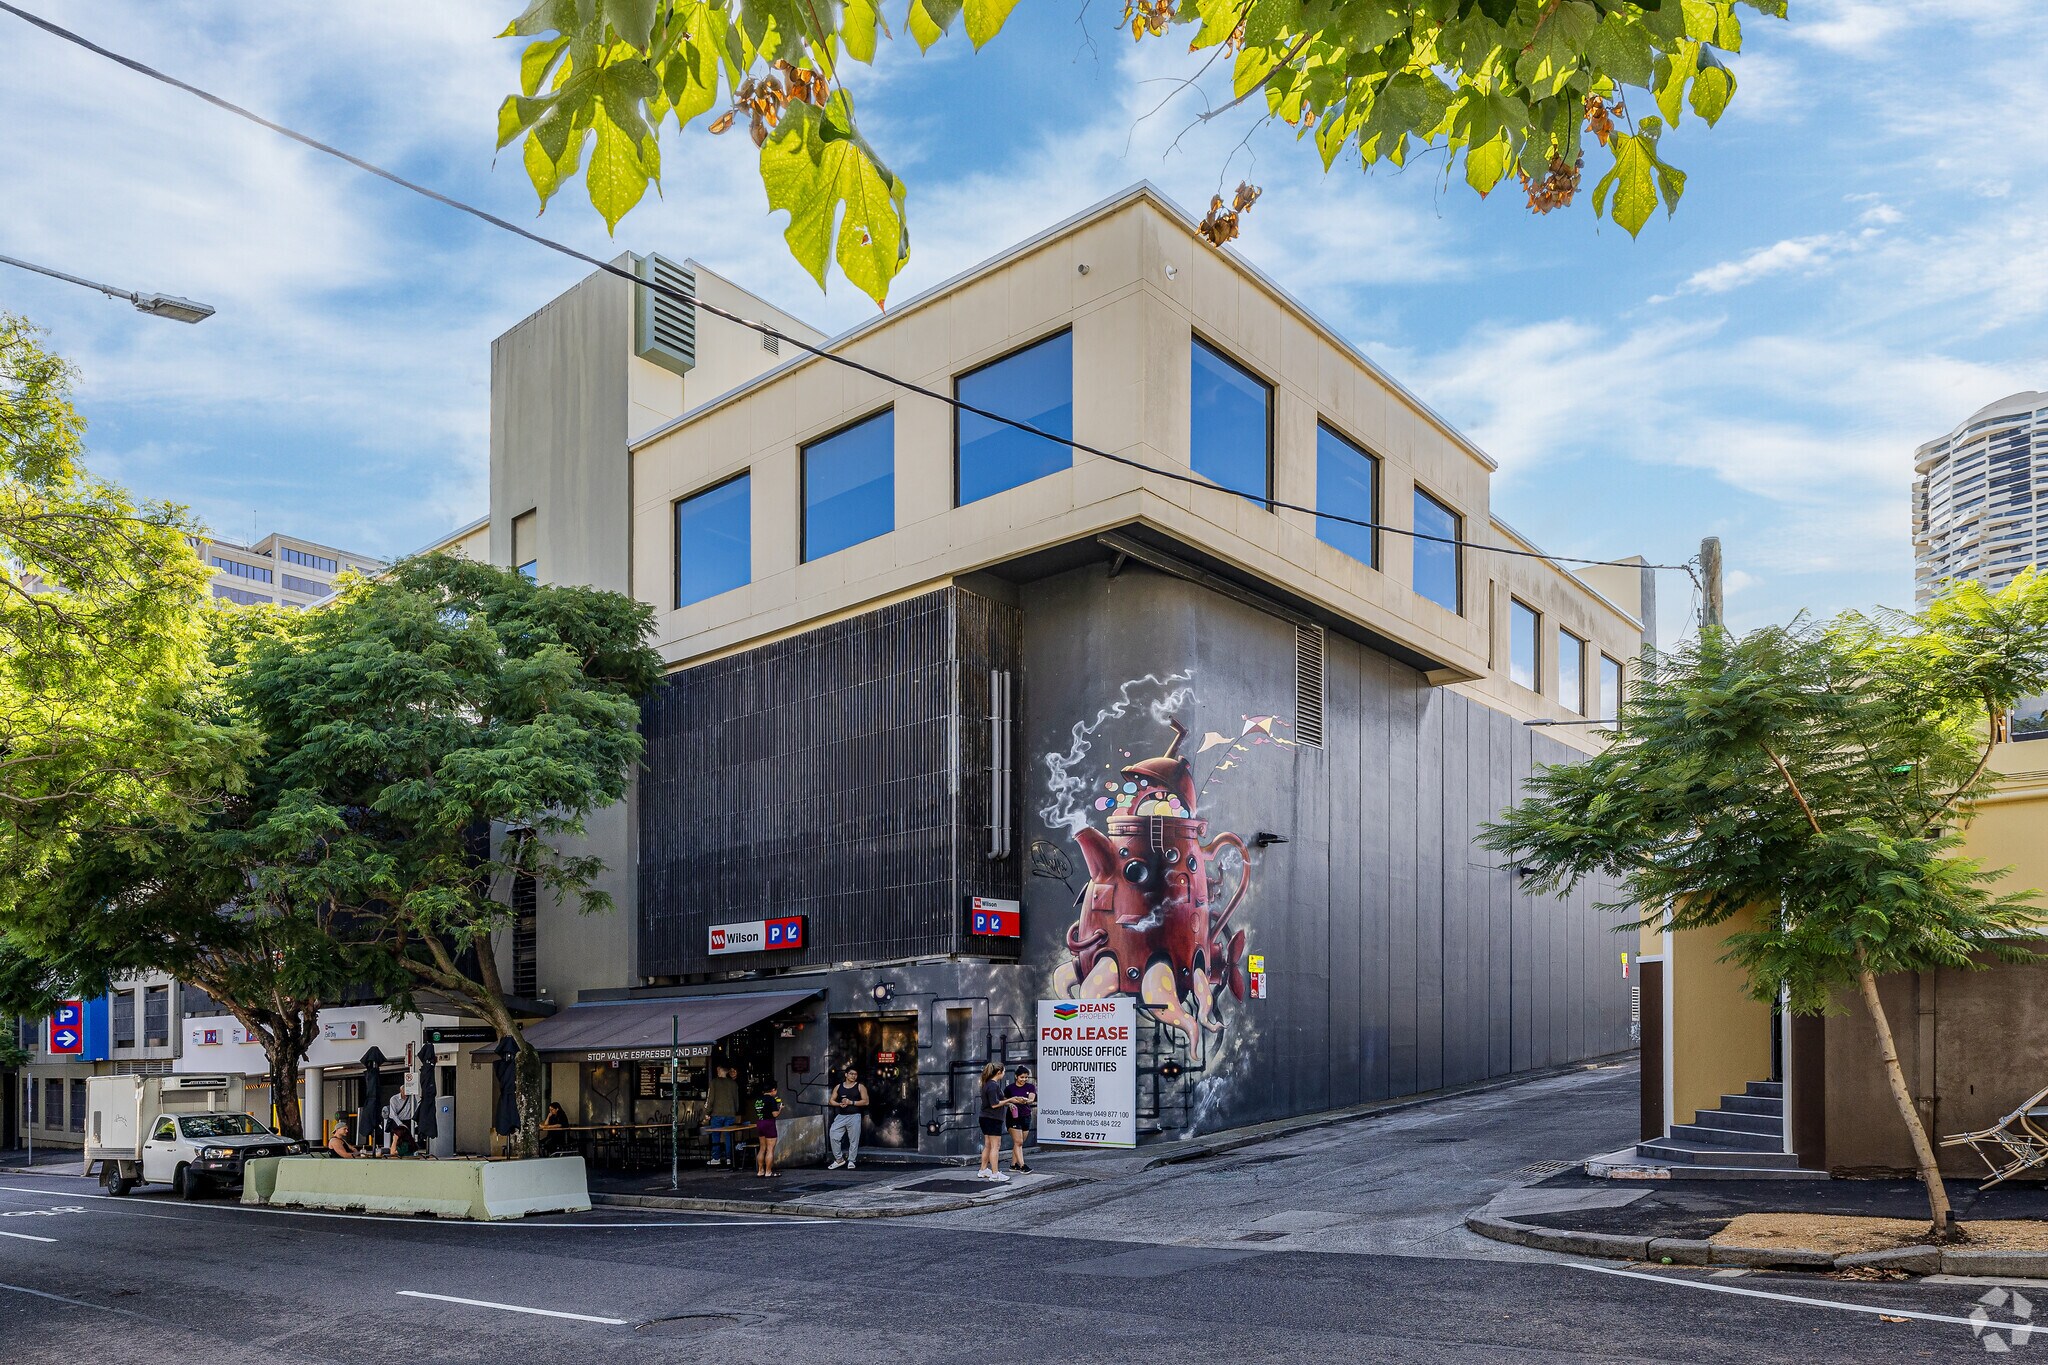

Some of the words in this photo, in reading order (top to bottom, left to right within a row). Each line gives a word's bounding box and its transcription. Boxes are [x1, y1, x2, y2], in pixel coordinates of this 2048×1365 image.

[977, 916, 984, 928] P
[727, 933, 758, 943] Wilson
[771, 927, 780, 940] P
[1079, 1003, 1115, 1012] DEANS
[60, 1009, 73, 1022] P
[1041, 1027, 1073, 1040] FOR
[1077, 1026, 1128, 1040] LEASE
[587, 1052, 606, 1060] STOP
[607, 1051, 628, 1060] VALVE
[630, 1049, 670, 1058] ESPRESSO
[692, 1046, 708, 1055] BAR
[1043, 1046, 1092, 1056] PENTHOUSE
[1096, 1046, 1126, 1056] OFFICE
[1052, 1062, 1116, 1072] OPPORTUNITIES
[1060, 1110, 1092, 1118] Deans-Harvey
[1060, 1131, 1082, 1139] 9282
[1084, 1132, 1106, 1140] 6777
